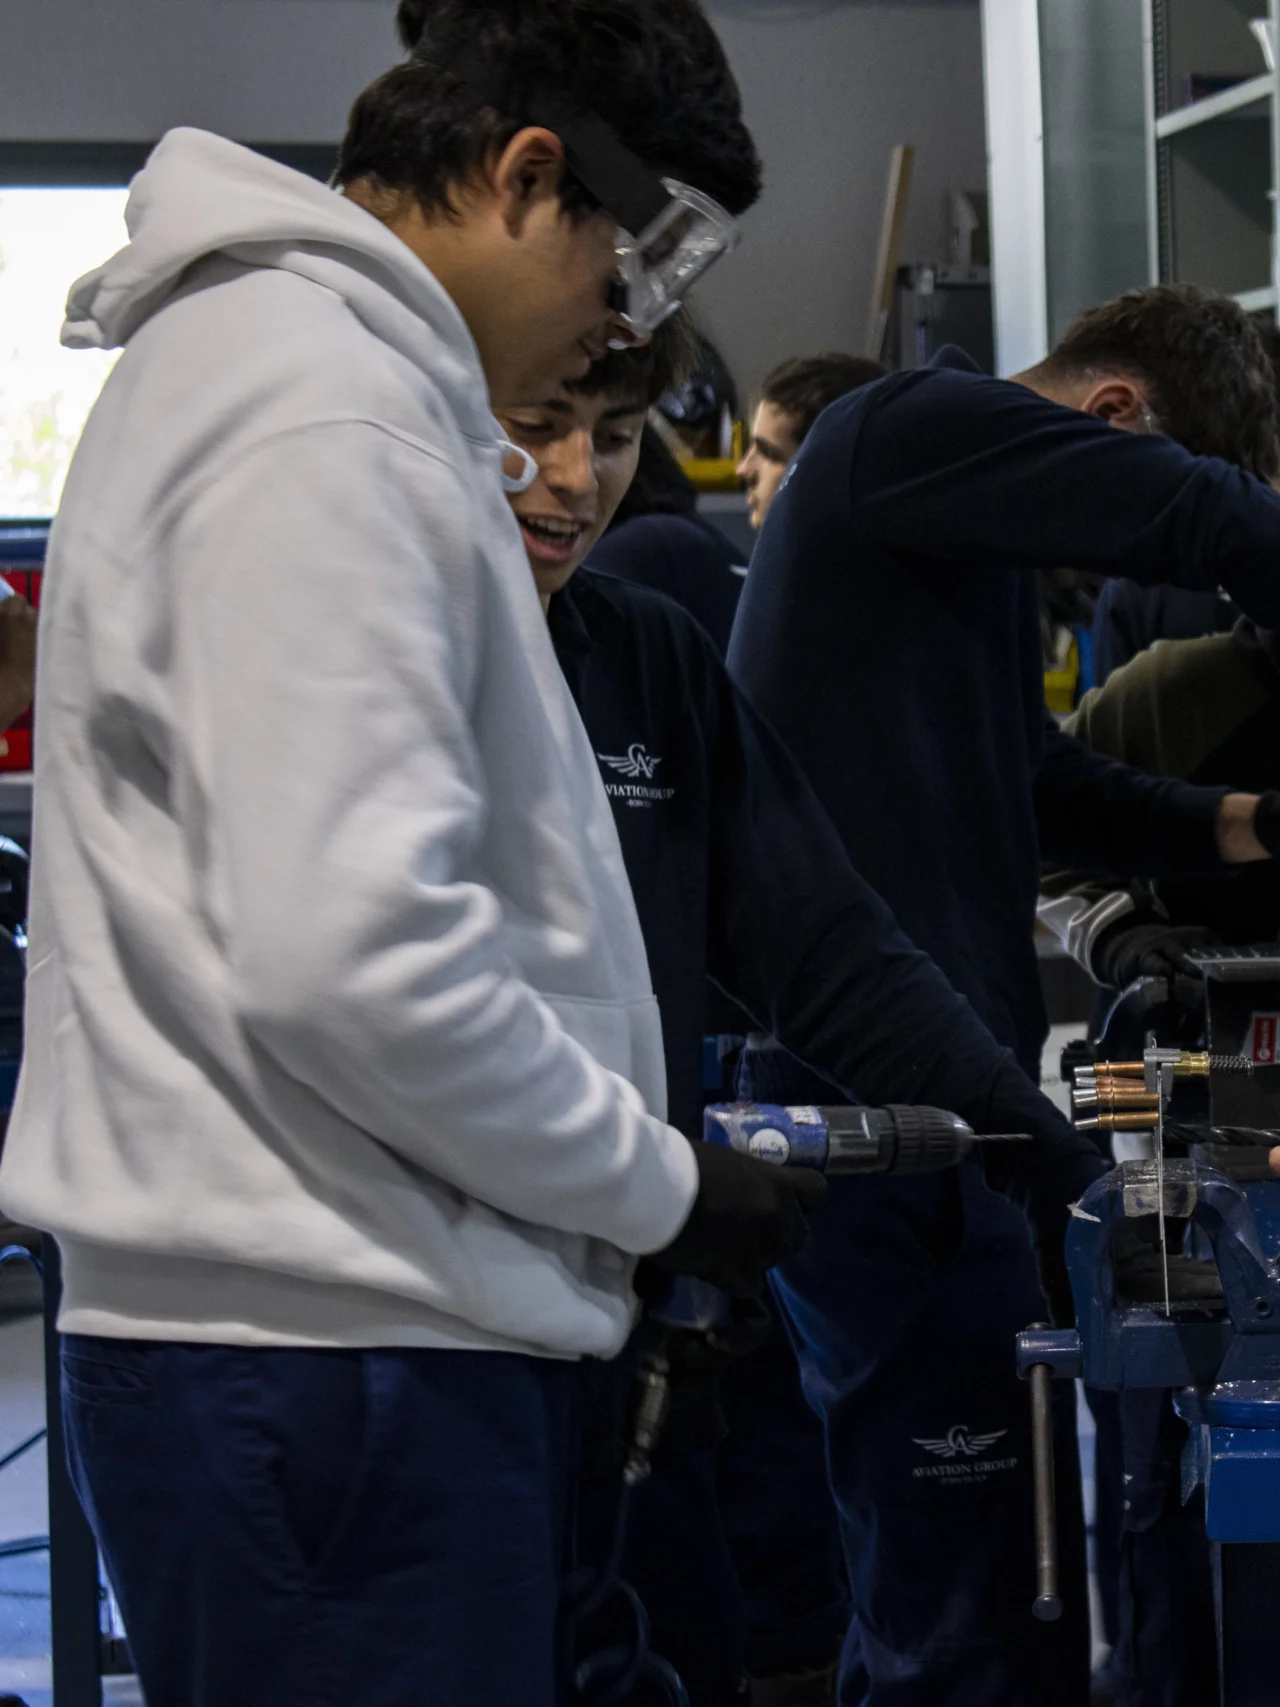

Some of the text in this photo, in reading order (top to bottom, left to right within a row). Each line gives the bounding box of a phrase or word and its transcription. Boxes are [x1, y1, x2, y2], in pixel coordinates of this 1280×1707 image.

[604, 784, 649, 797] VIATION
[912, 1456, 1018, 1478] AVIATION GROUP
